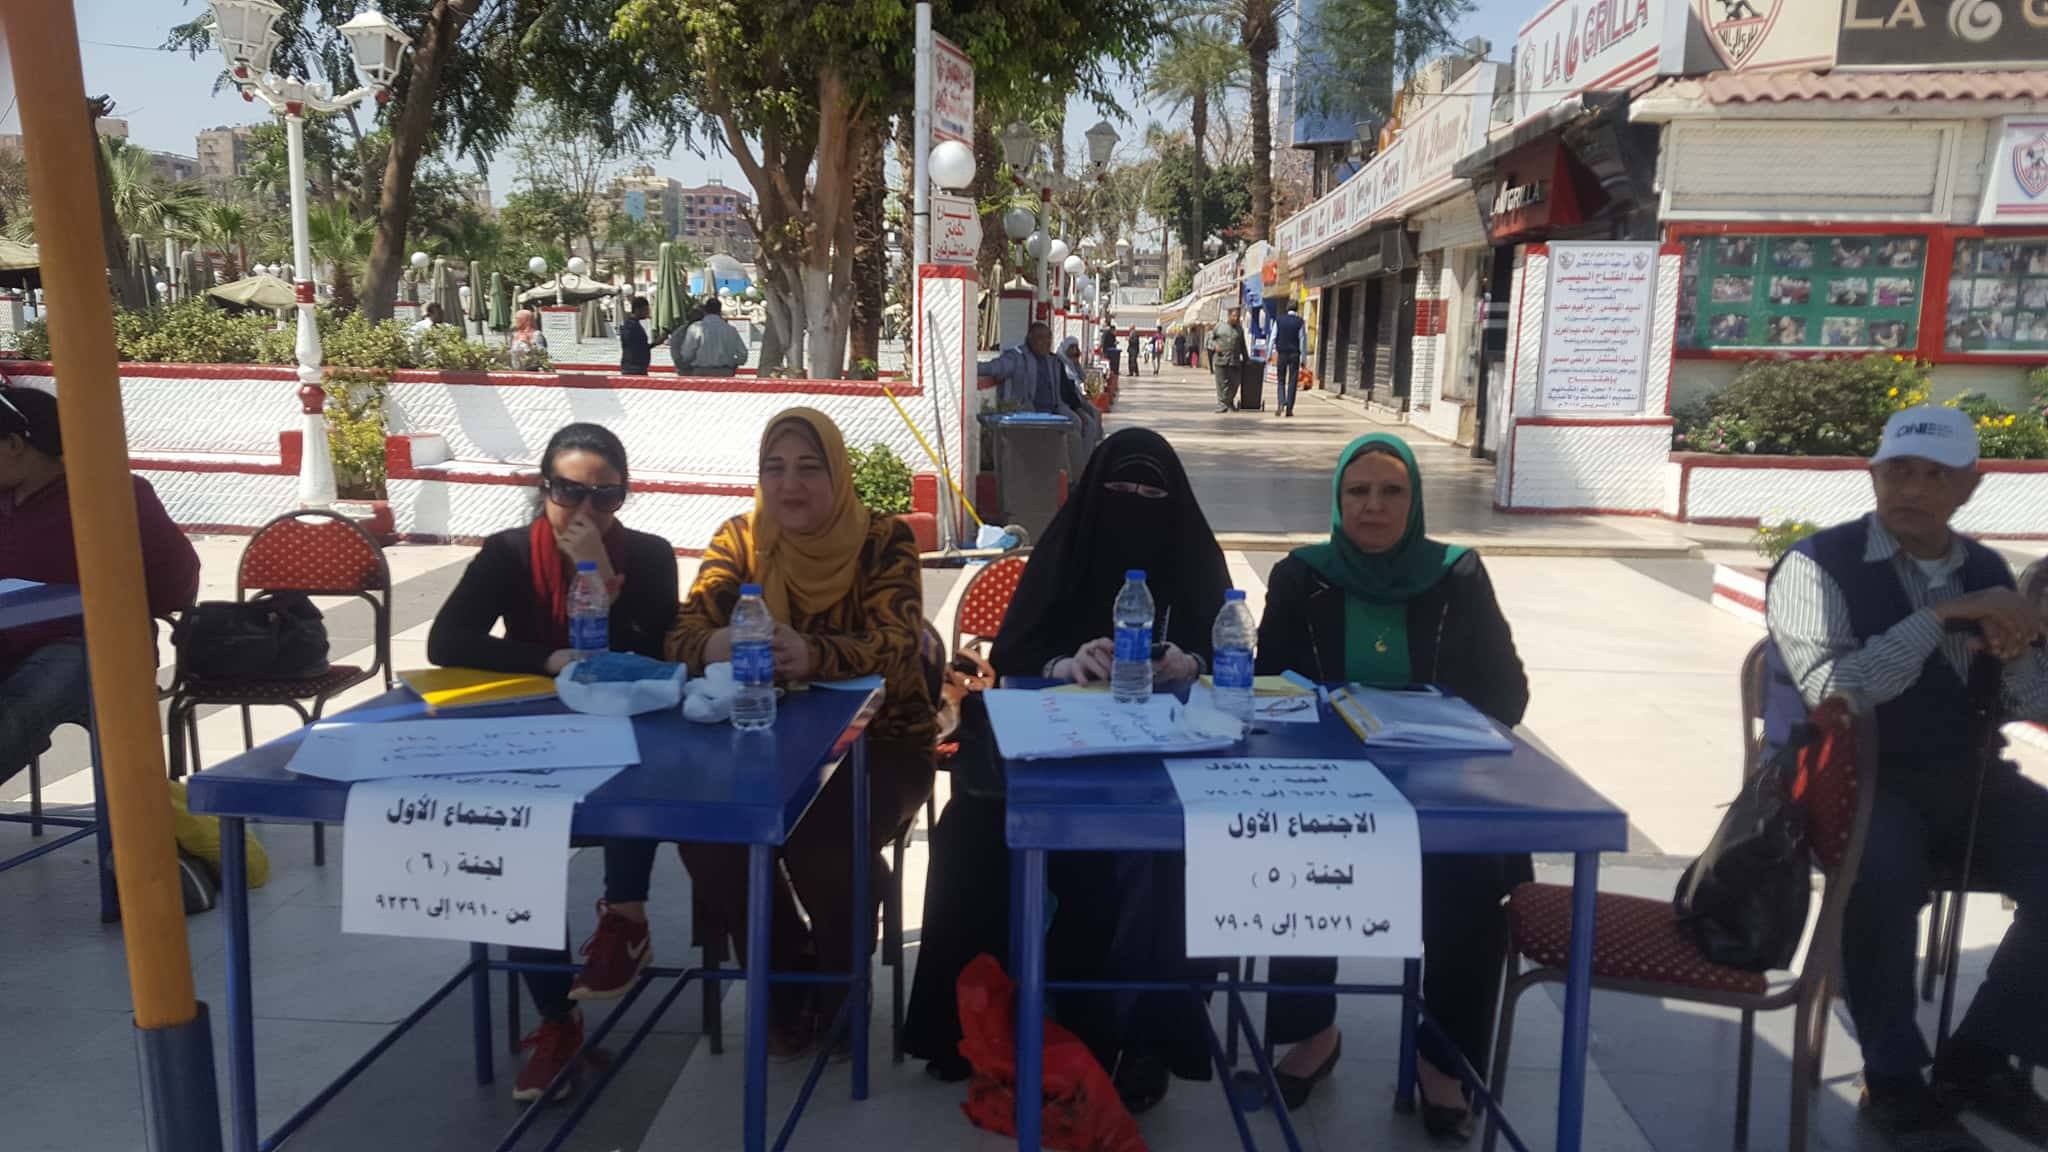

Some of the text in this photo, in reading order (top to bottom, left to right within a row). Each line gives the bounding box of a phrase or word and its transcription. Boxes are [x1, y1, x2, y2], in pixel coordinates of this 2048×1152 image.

[1844, 0, 1927, 30] LA
[1543, 32, 1561, 88] LA
[387, 793, 532, 831] الاجتماع الأول
[1228, 808, 1376, 838] الاجتماع الأول
[457, 852, 503, 880] لجنة
[1305, 862, 1354, 890] لجنة
[426, 898, 450, 920] إلى
[456, 900, 499, 917] ٧٩١٠
[505, 909, 531, 924] من
[1214, 912, 1390, 938] من ٦٥٧١ إلى ٧٩٠٩
